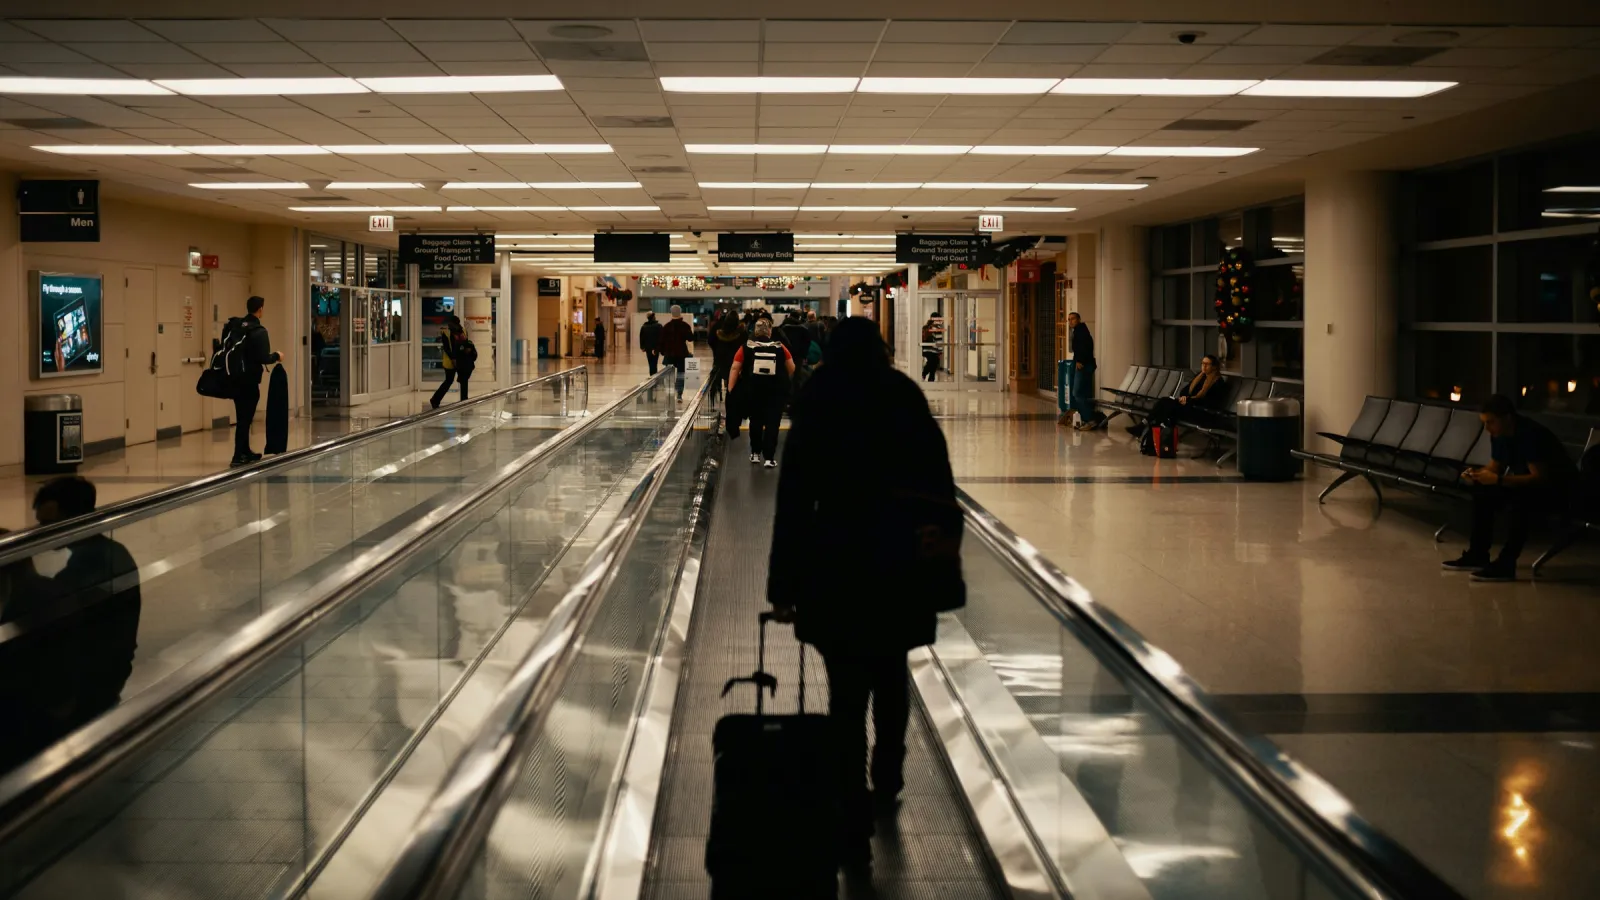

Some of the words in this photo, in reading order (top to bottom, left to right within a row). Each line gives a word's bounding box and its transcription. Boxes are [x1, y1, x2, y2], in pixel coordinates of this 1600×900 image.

[70, 217, 94, 227] Men
[372, 217, 389, 228] EXIT
[982, 217, 999, 228] EXIT
[42, 284, 50, 295] Fly
[49, 284, 65, 295] through
[549, 280, 560, 288] B1
